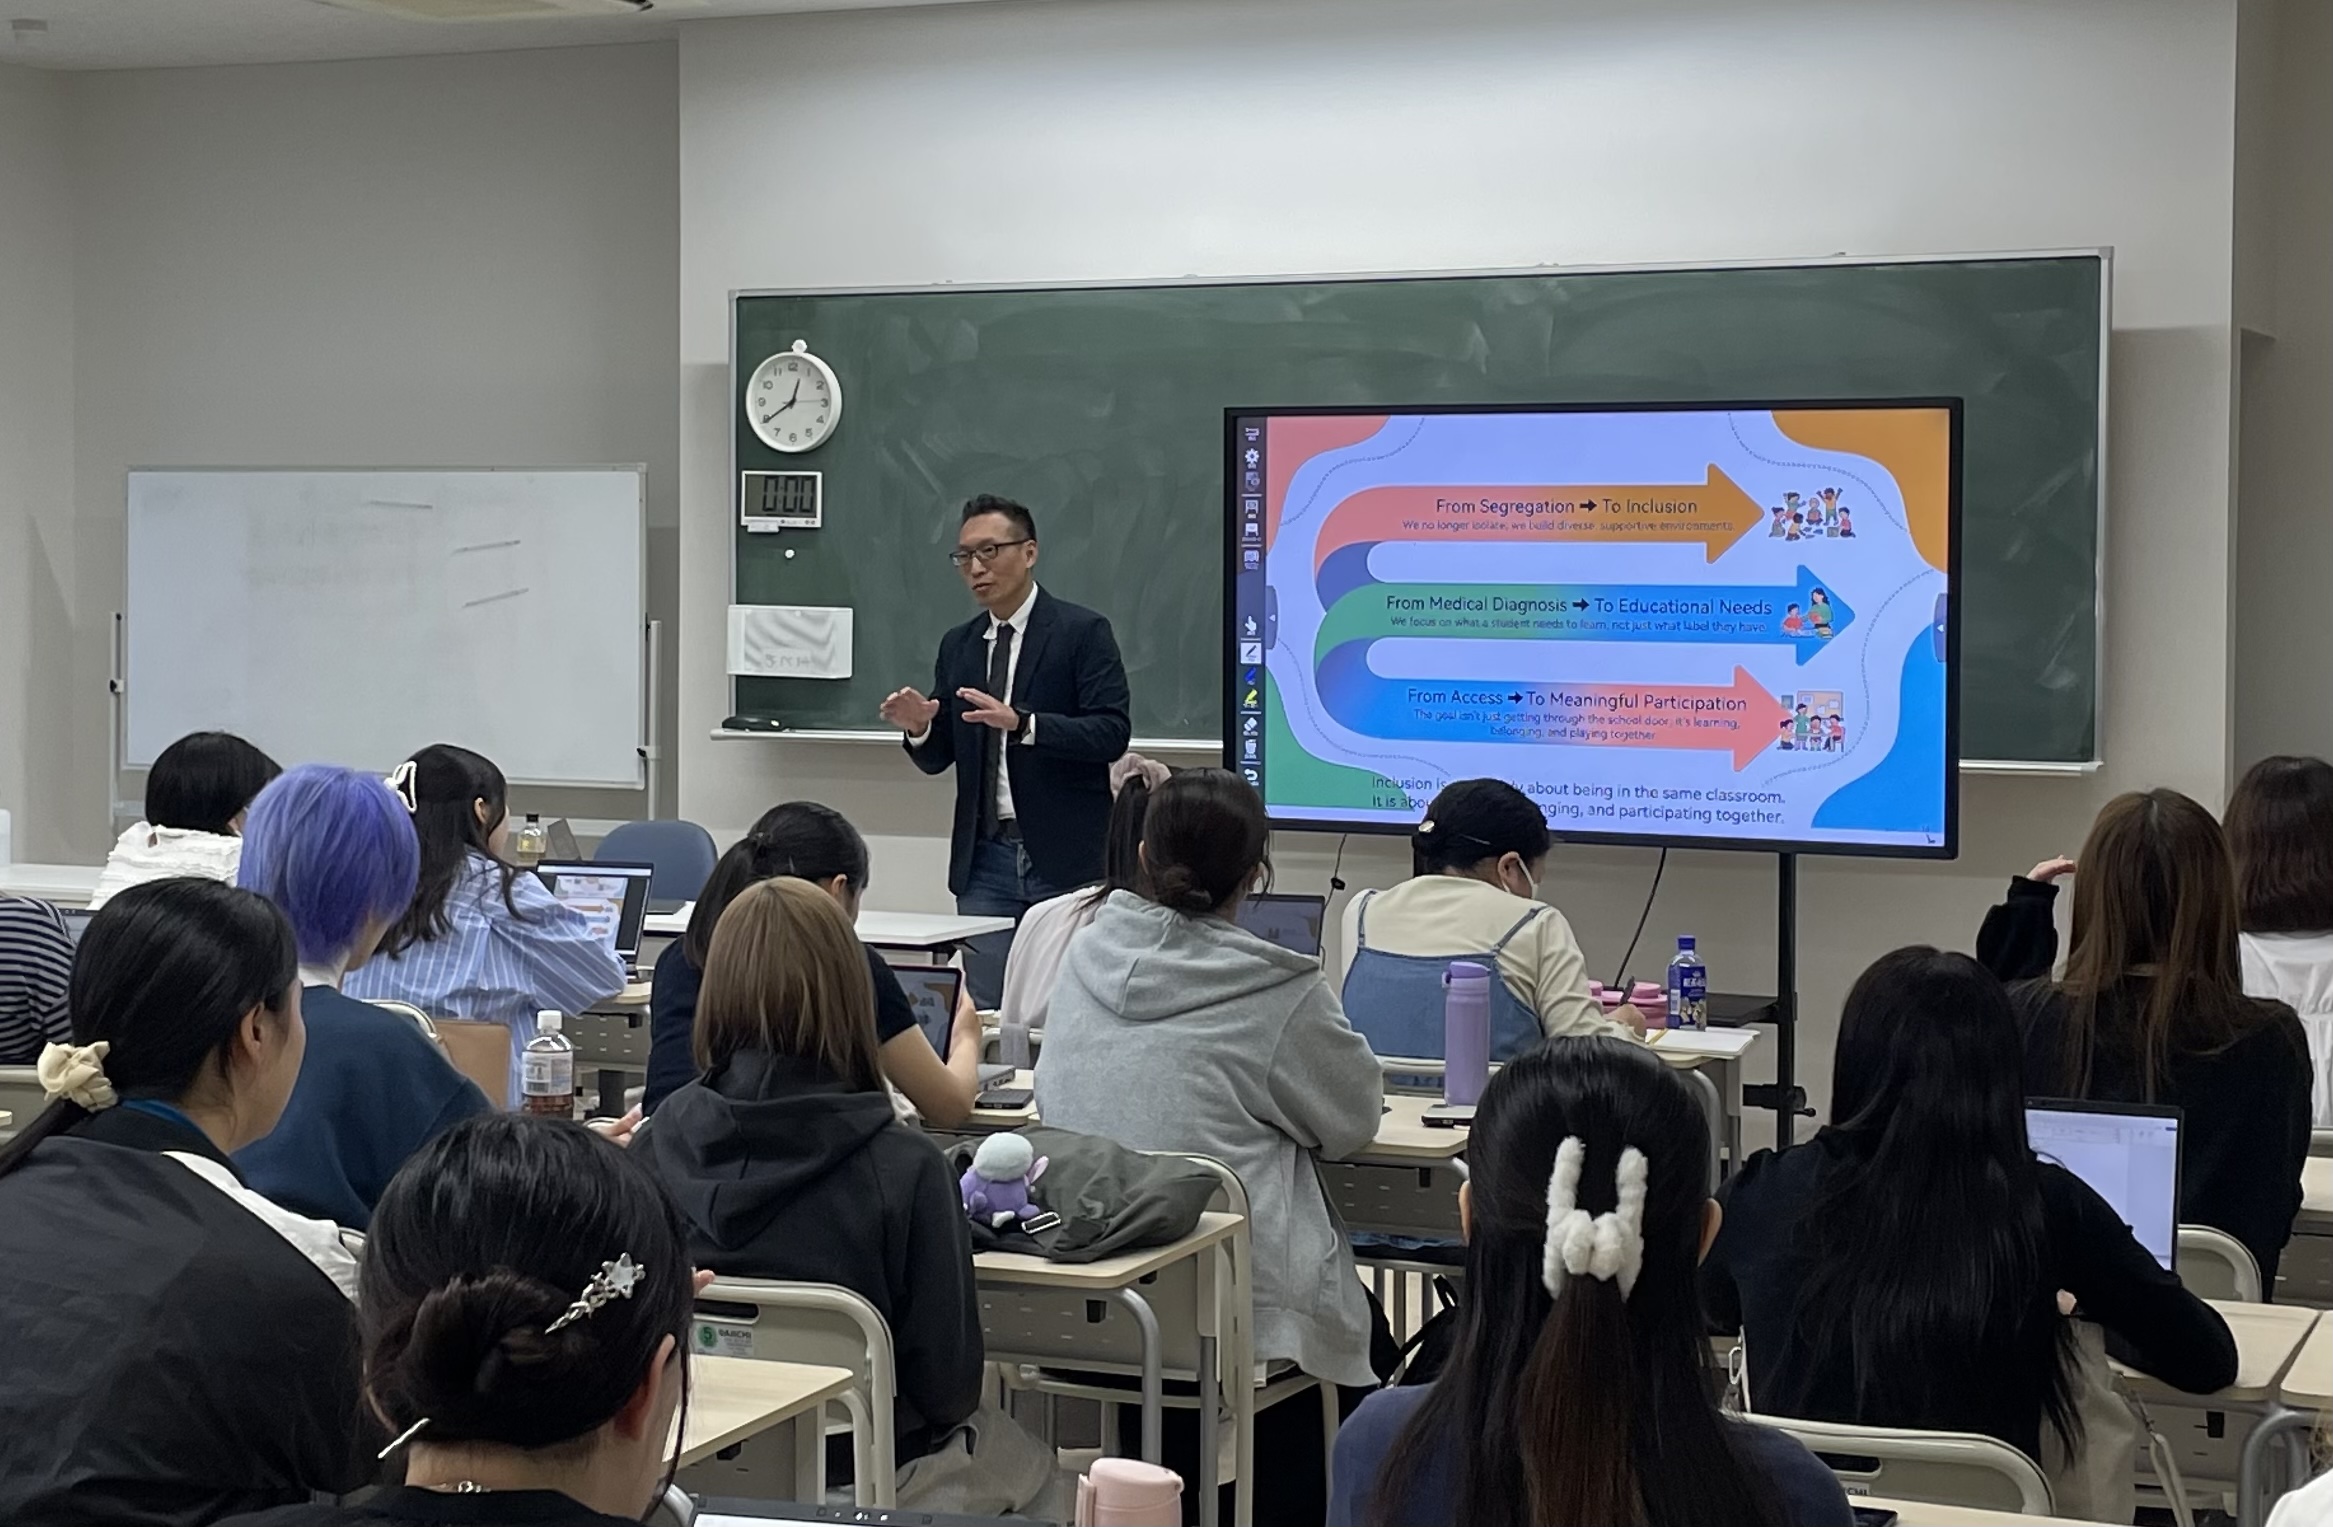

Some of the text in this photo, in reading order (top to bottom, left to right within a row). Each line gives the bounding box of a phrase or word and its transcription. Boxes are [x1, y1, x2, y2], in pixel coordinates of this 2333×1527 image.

[773, 367, 782, 376] 11
[788, 362, 798, 372] 12
[763, 380, 774, 390] 10
[816, 381, 824, 390] 2
[758, 397, 766, 407] 9
[820, 398, 828, 408] 3
[816, 415, 824, 424] 4
[774, 428, 781, 436] 7
[805, 428, 813, 438] 5
[789, 433, 797, 442] 6
[1436, 499, 1697, 517] From Segregation To Inclusion
[1402, 520, 1420, 530] We
[1422, 522, 1434, 530] no
[1437, 520, 1469, 532] longer
[1512, 522, 1526, 530] we
[1529, 520, 1554, 531] build
[1600, 522, 1657, 532] supportive
[1386, 596, 1772, 615] From Medical Diagnosis To Educational Needs
[1391, 616, 1406, 626] We
[1409, 616, 1436, 626] focus
[1438, 618, 1451, 627] on
[1454, 617, 1480, 628] what
[1482, 619, 1489, 628] a
[1492, 618, 1530, 628] student
[1532, 618, 1564, 628] needs
[1566, 619, 1578, 628] to
[1580, 618, 1610, 630] learn,
[1612, 620, 1630, 630] not
[1632, 620, 1651, 632] just
[1655, 620, 1680, 631] what
[1684, 620, 1710, 632] label
[1712, 621, 1736, 634] they
[1408, 688, 1747, 713] From Access To Meaningful Participation
[1414, 709, 1432, 720] The
[1436, 711, 1456, 722] goal
[1482, 712, 1500, 722] just
[1504, 713, 1541, 725] getting
[1544, 713, 1584, 726] through
[1588, 714, 1605, 724] the
[1608, 716, 1642, 725] school
[1676, 718, 1690, 726] it's
[1694, 717, 1740, 730] learning,
[1548, 728, 1566, 737] and
[1570, 728, 1608, 740] playing
[1372, 776, 1432, 790] Inclusion
[1528, 782, 1569, 795] about
[1574, 784, 1612, 799] being
[1618, 784, 1630, 798] in
[1634, 785, 1658, 798] the
[1662, 788, 1701, 800] same
[1706, 788, 1786, 804] classroom.
[1373, 796, 1382, 808] It
[1386, 796, 1396, 808] is
[1588, 804, 1614, 817] and
[1620, 806, 1712, 824] participating
[1716, 808, 1784, 825] together.
